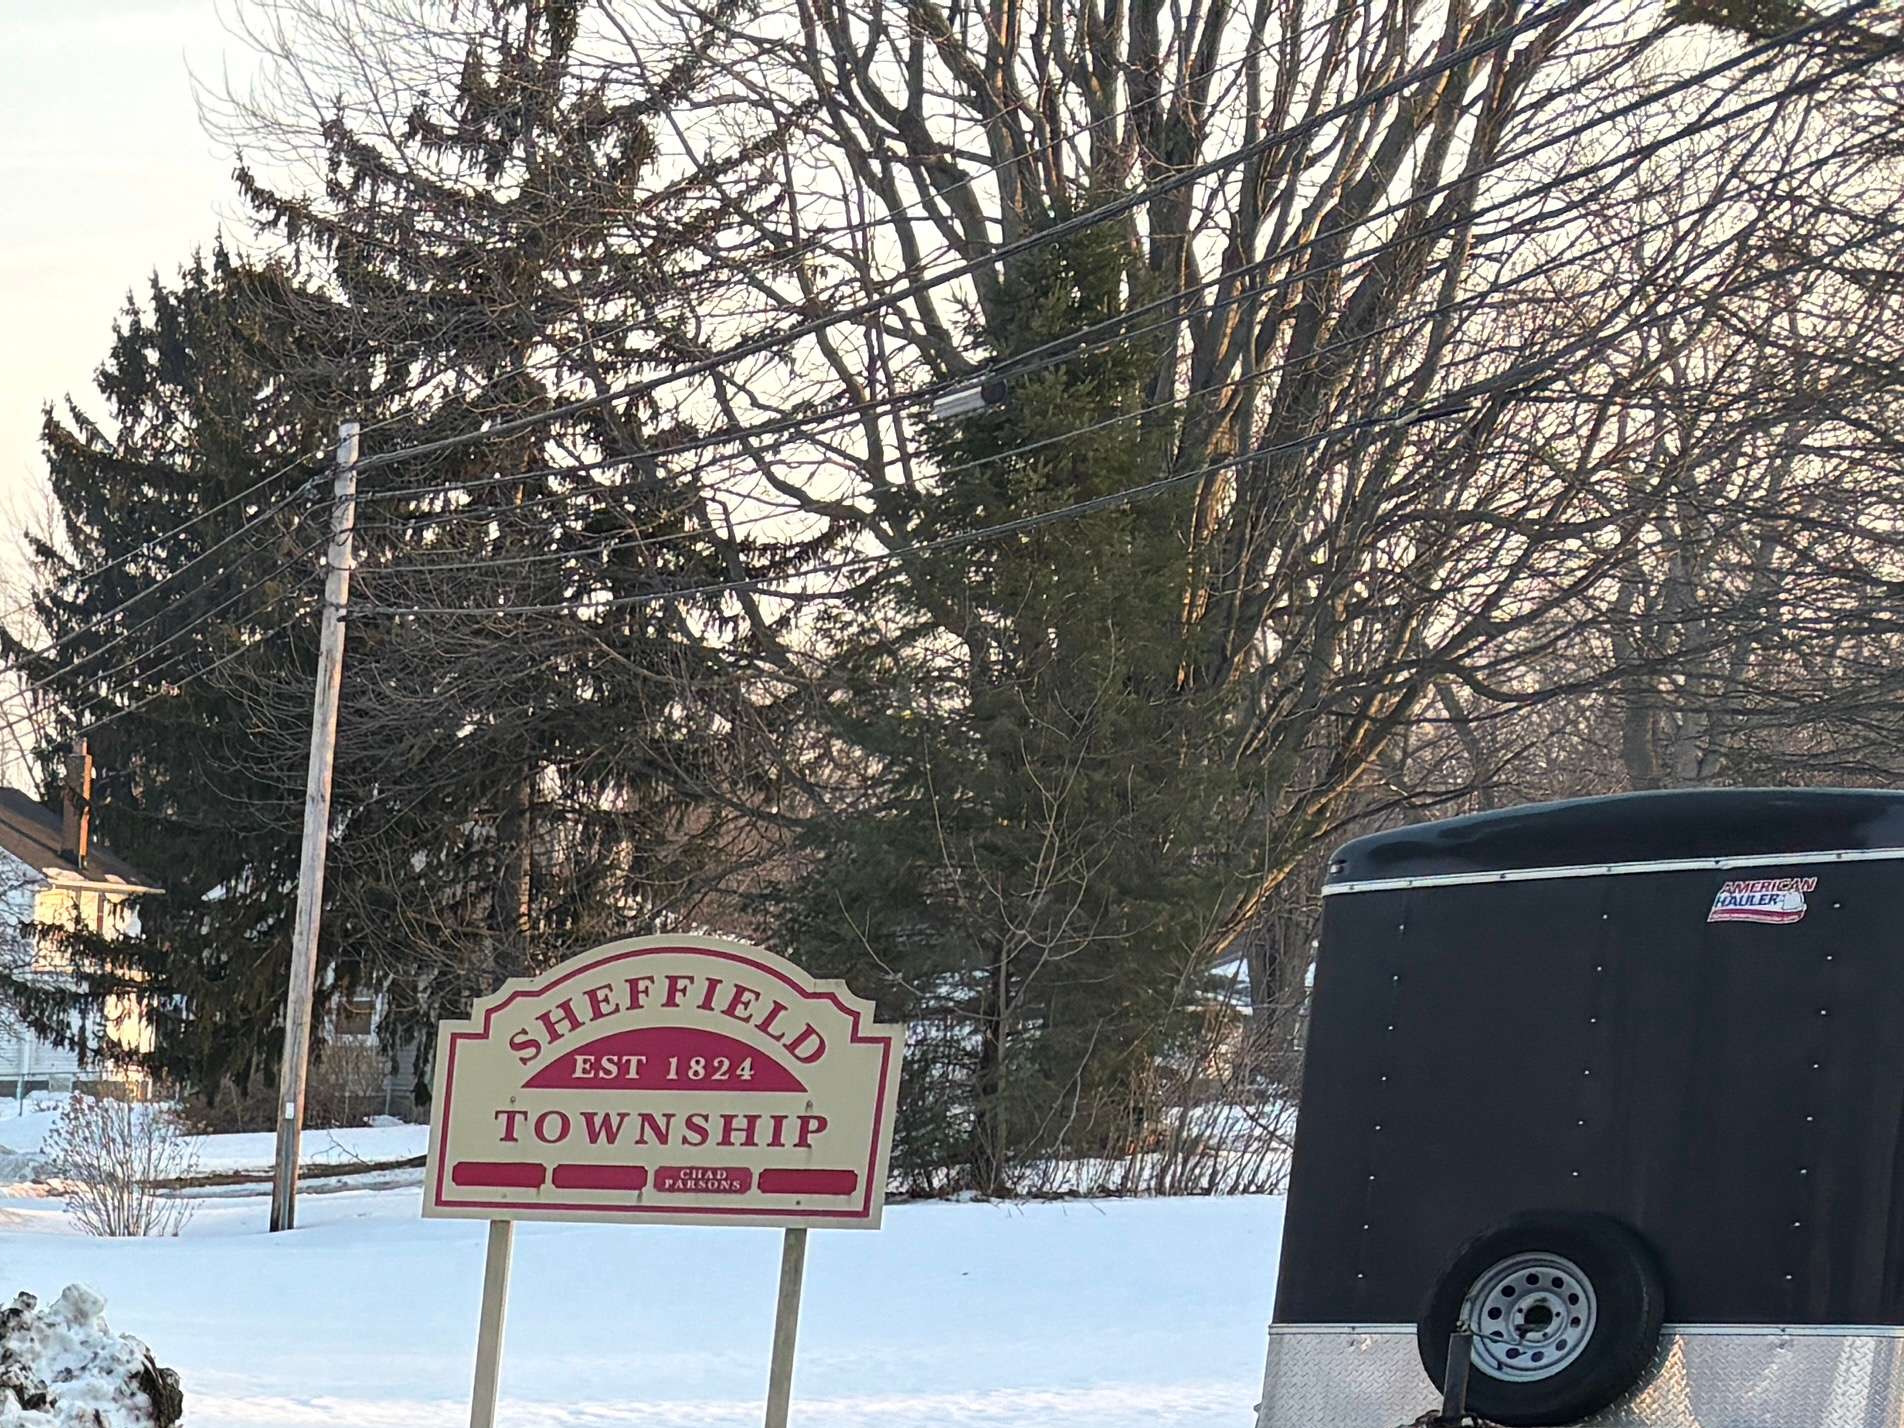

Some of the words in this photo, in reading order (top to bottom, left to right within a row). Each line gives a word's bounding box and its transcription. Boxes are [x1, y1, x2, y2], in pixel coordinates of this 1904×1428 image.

[1722, 877, 1817, 894] AMERICAN
[1716, 893, 1780, 907] HAULER
[508, 974, 828, 1067] SHEFFIELD
[571, 1054, 647, 1080] EST
[665, 1054, 756, 1081] 1824
[494, 1108, 829, 1149] TOWNSHIP
[680, 1168, 727, 1179] CHAD
[664, 1179, 741, 1191] PARSONS
